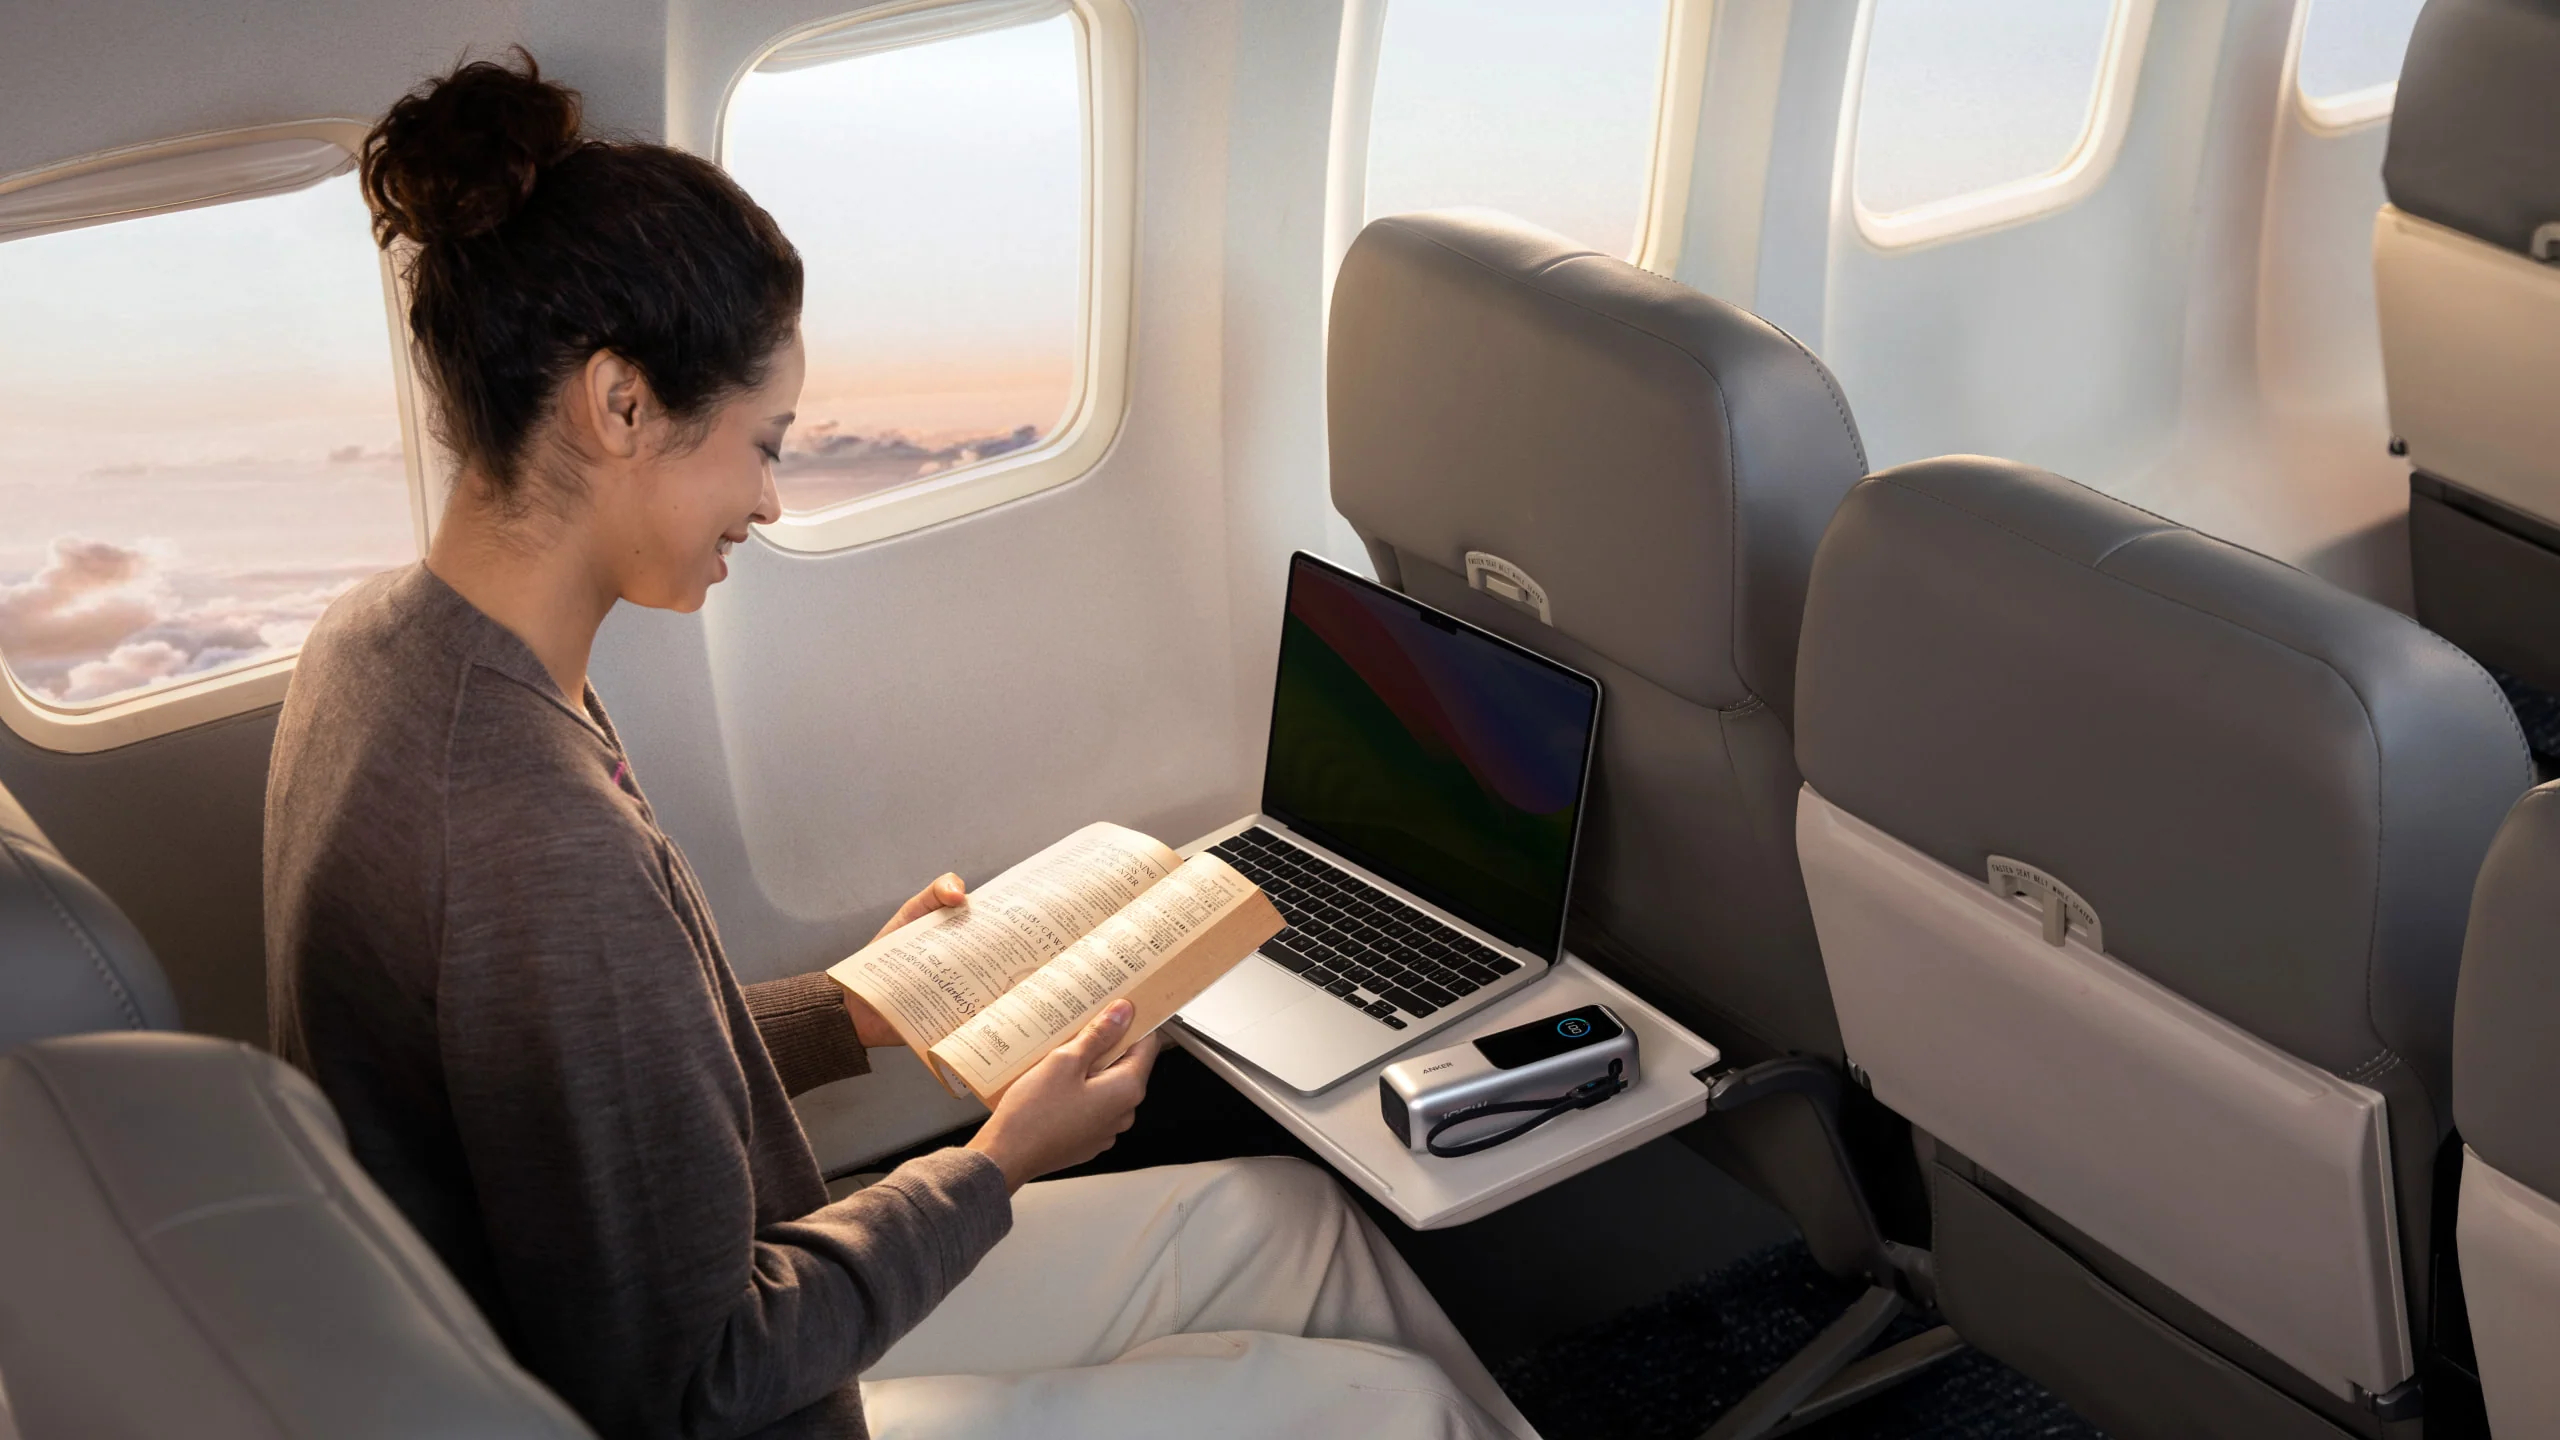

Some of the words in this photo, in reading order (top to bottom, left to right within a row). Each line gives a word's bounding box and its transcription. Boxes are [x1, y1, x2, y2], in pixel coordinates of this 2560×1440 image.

[1992, 864, 2013, 874] FASTEN
[2016, 868, 2030, 879] SEAT
[2034, 874, 2048, 888] BELT
[2073, 903, 2093, 925] SEATED
[981, 1024, 1010, 1051] Radisson
[1565, 1021, 1582, 1034] 100
[1423, 1061, 1453, 1075] ANKER
